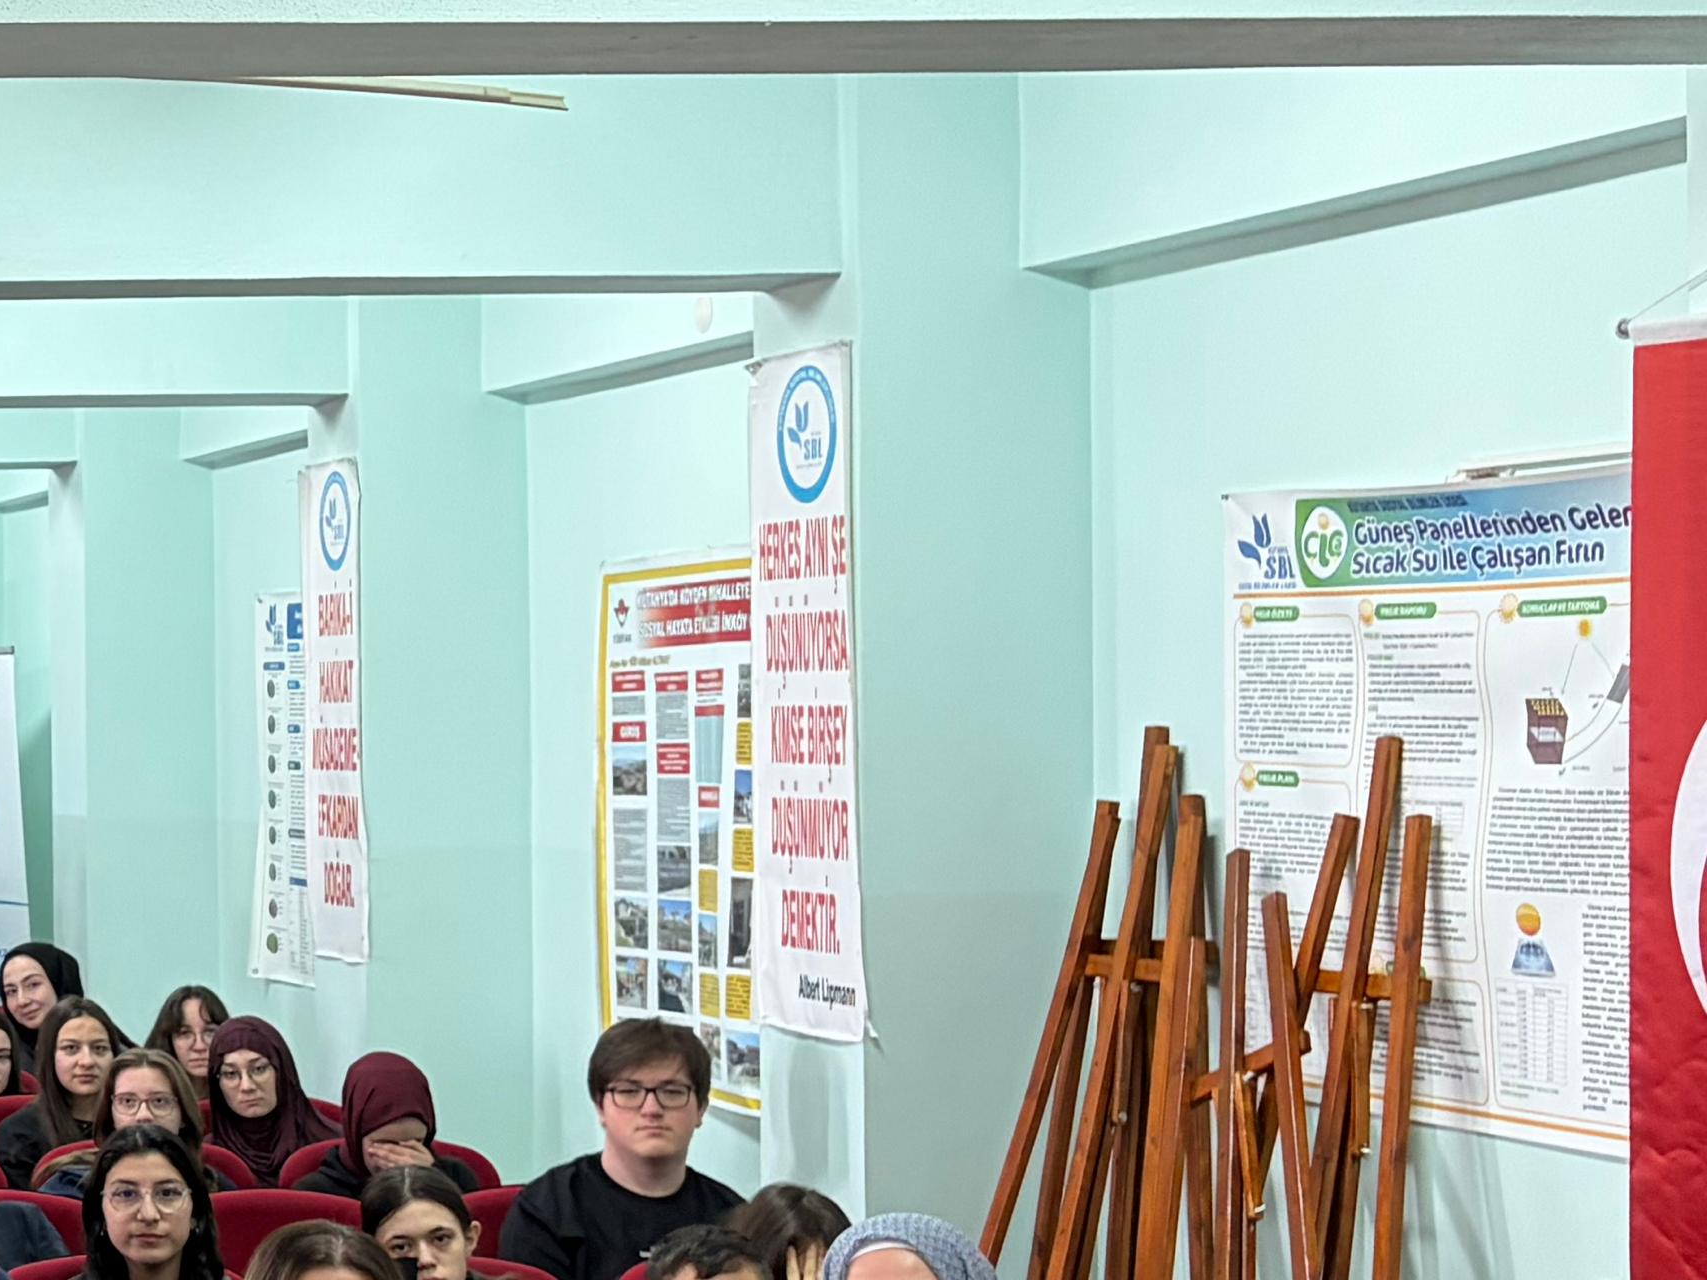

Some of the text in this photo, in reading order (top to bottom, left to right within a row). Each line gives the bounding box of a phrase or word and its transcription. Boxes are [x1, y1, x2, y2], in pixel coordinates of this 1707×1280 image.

[759, 519, 801, 581] HERKES
[803, 517, 829, 578] AYNI
[1353, 515, 1414, 545] Güneş
[1415, 509, 1567, 541] Panellerinden
[1352, 539, 1605, 577] Sıcak Su İle Çalışan Fırın
[770, 687, 805, 765] KİMSE
[807, 687, 848, 784] BİRŞEY
[771, 780, 849, 874] DÜŞÜNMÜYOR
[798, 973, 820, 1001] Albert
